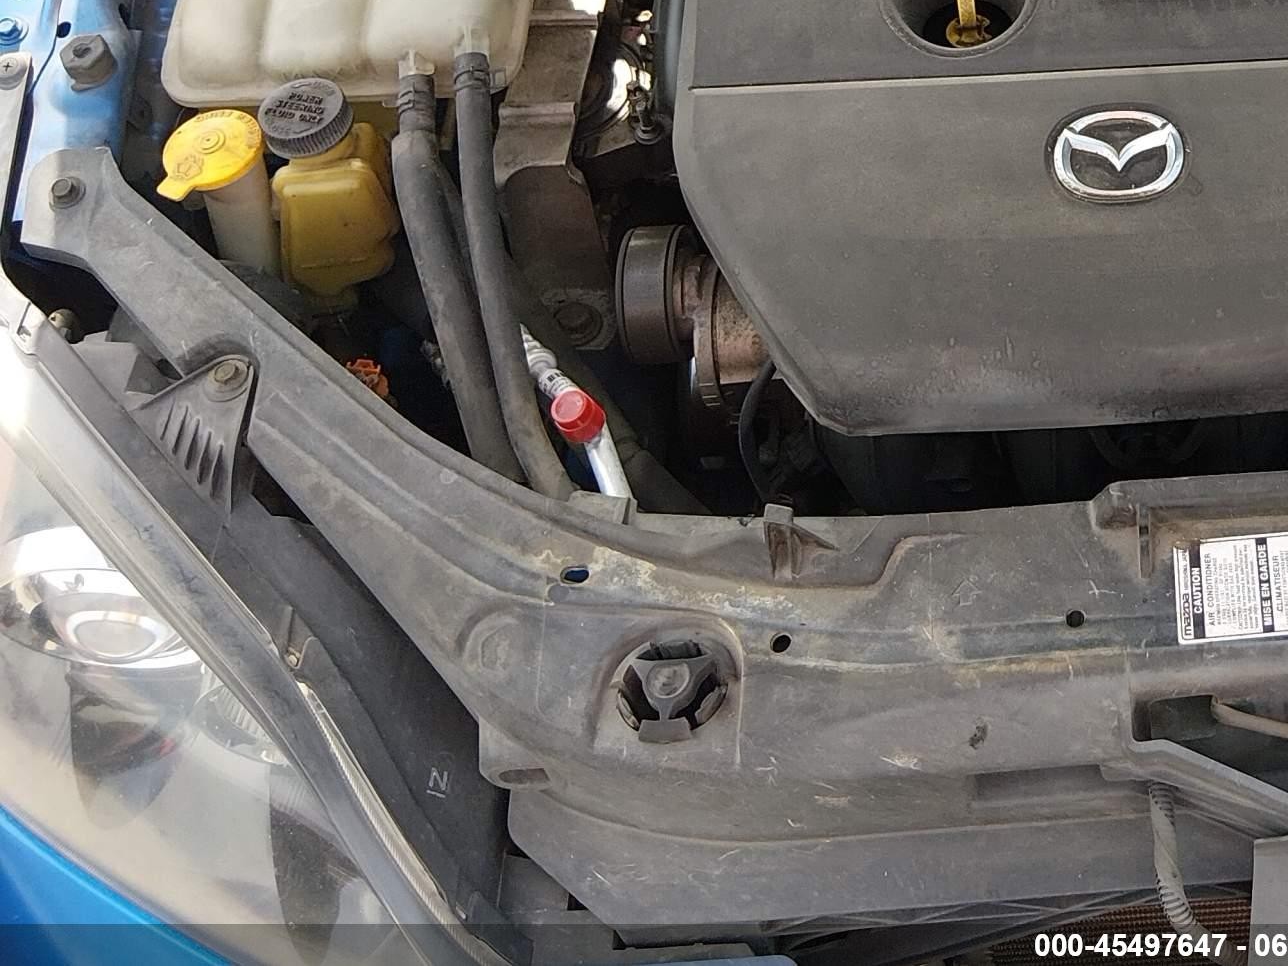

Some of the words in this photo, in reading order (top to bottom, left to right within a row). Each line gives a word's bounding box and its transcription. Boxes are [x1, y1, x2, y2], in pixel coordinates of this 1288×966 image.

[1258, 544, 1269, 580] GARDE
[1191, 567, 1203, 614] CAUTION
[1204, 553, 1215, 609] CONDITIONER
[1259, 583, 1270, 597] EN
[1273, 555, 1283, 612] CLIMATISEUR
[1208, 612, 1216, 626] AIR
[1261, 600, 1272, 626] MISE
